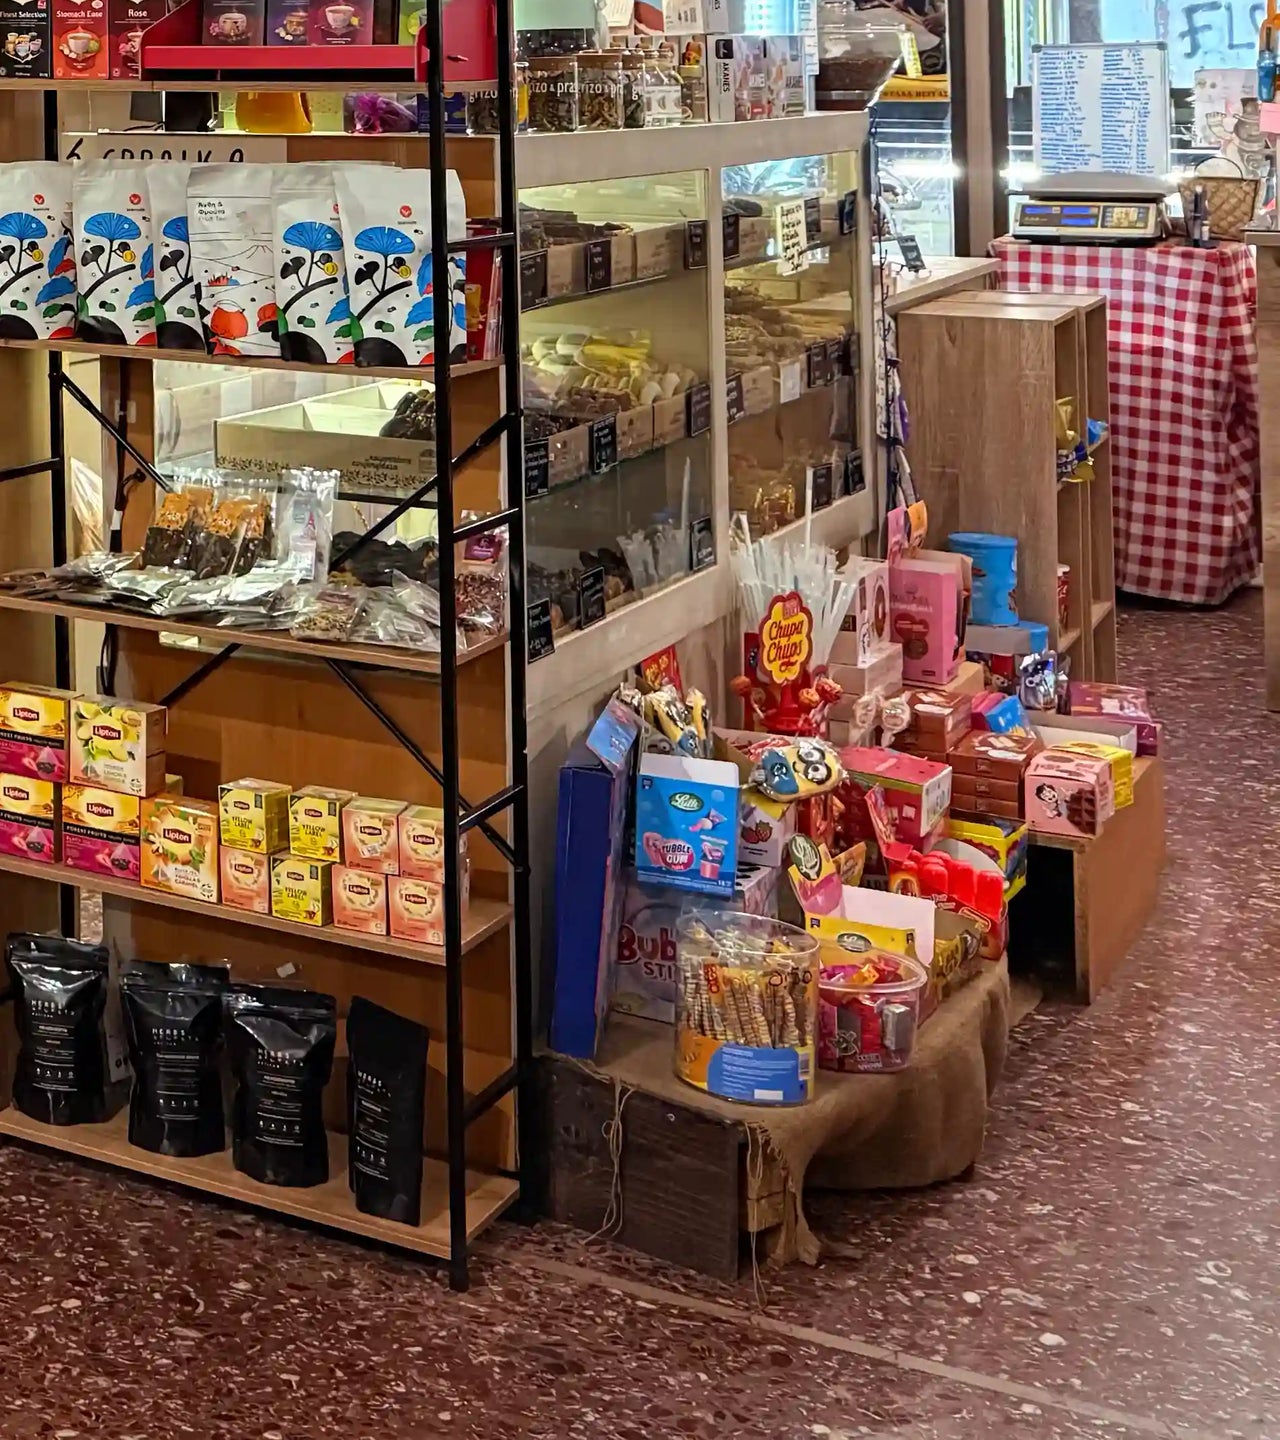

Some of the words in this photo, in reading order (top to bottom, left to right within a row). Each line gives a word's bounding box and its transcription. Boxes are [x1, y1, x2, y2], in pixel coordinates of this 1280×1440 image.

[57, 10, 85, 18] Stomach
[128, 9, 147, 17] Rose
[769, 621, 803, 641] Chupa
[767, 640, 802, 661] Chups
[15, 709, 37, 719] Lipton
[94, 727, 119, 738] Lipton
[5, 788, 27, 799] Lipton
[89, 804, 112, 815] Lipton
[666, 854, 688, 864] GUM
